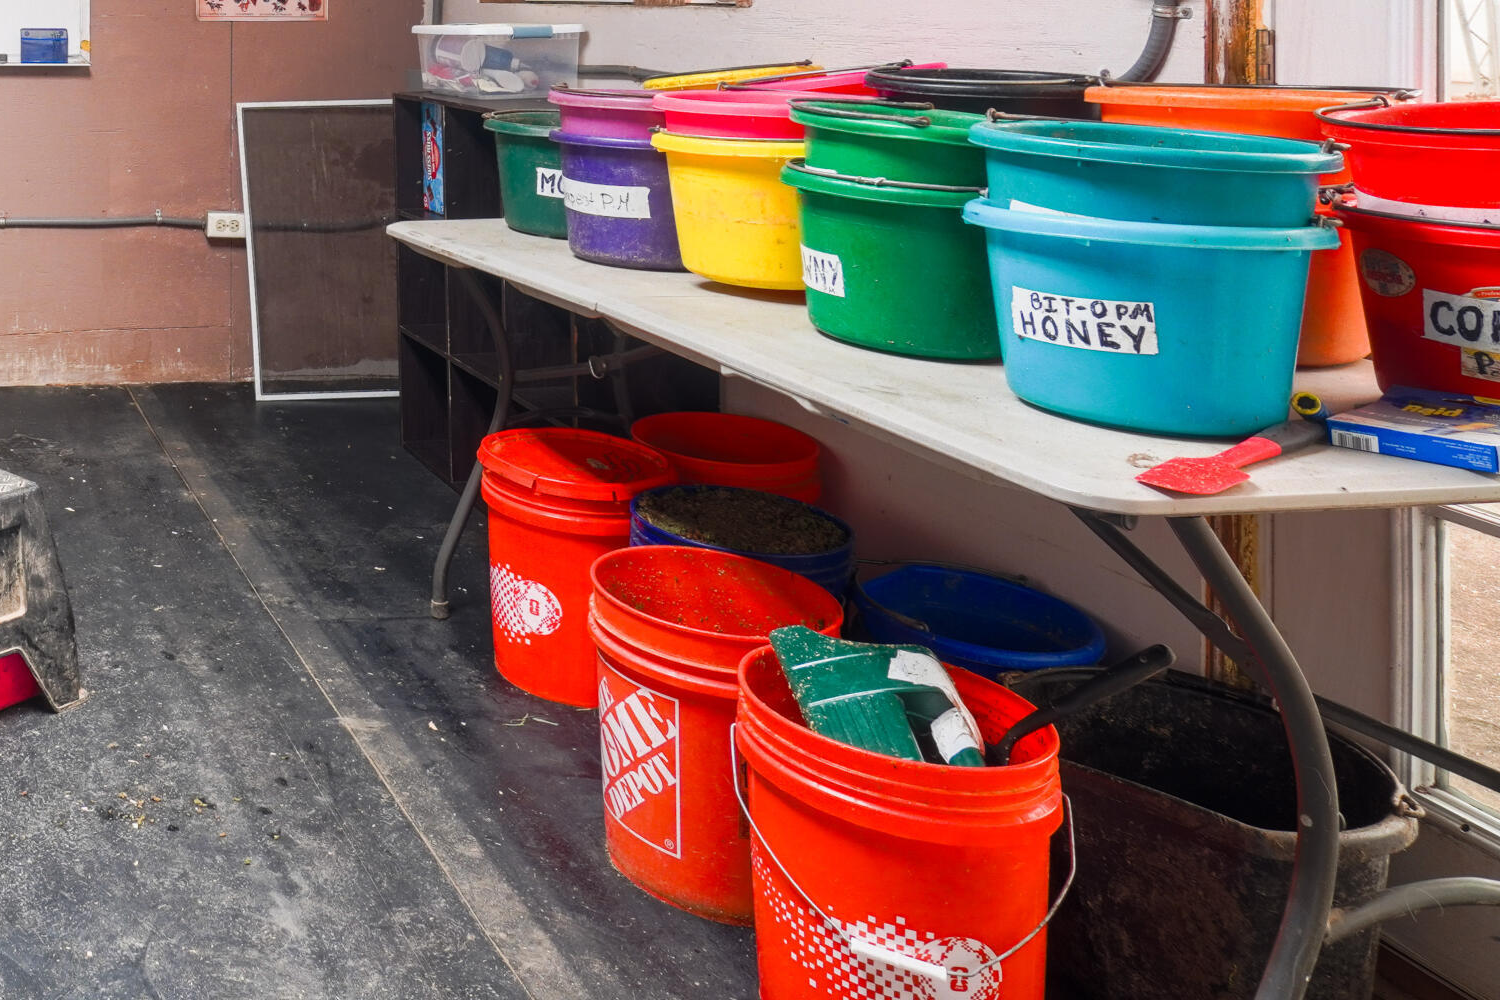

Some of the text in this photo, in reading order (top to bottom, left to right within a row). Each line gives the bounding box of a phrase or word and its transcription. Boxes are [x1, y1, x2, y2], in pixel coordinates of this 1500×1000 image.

[803, 251, 838, 286] WNY
[1020, 310, 1145, 354] HONEY
[608, 752, 676, 819] DEPOT
